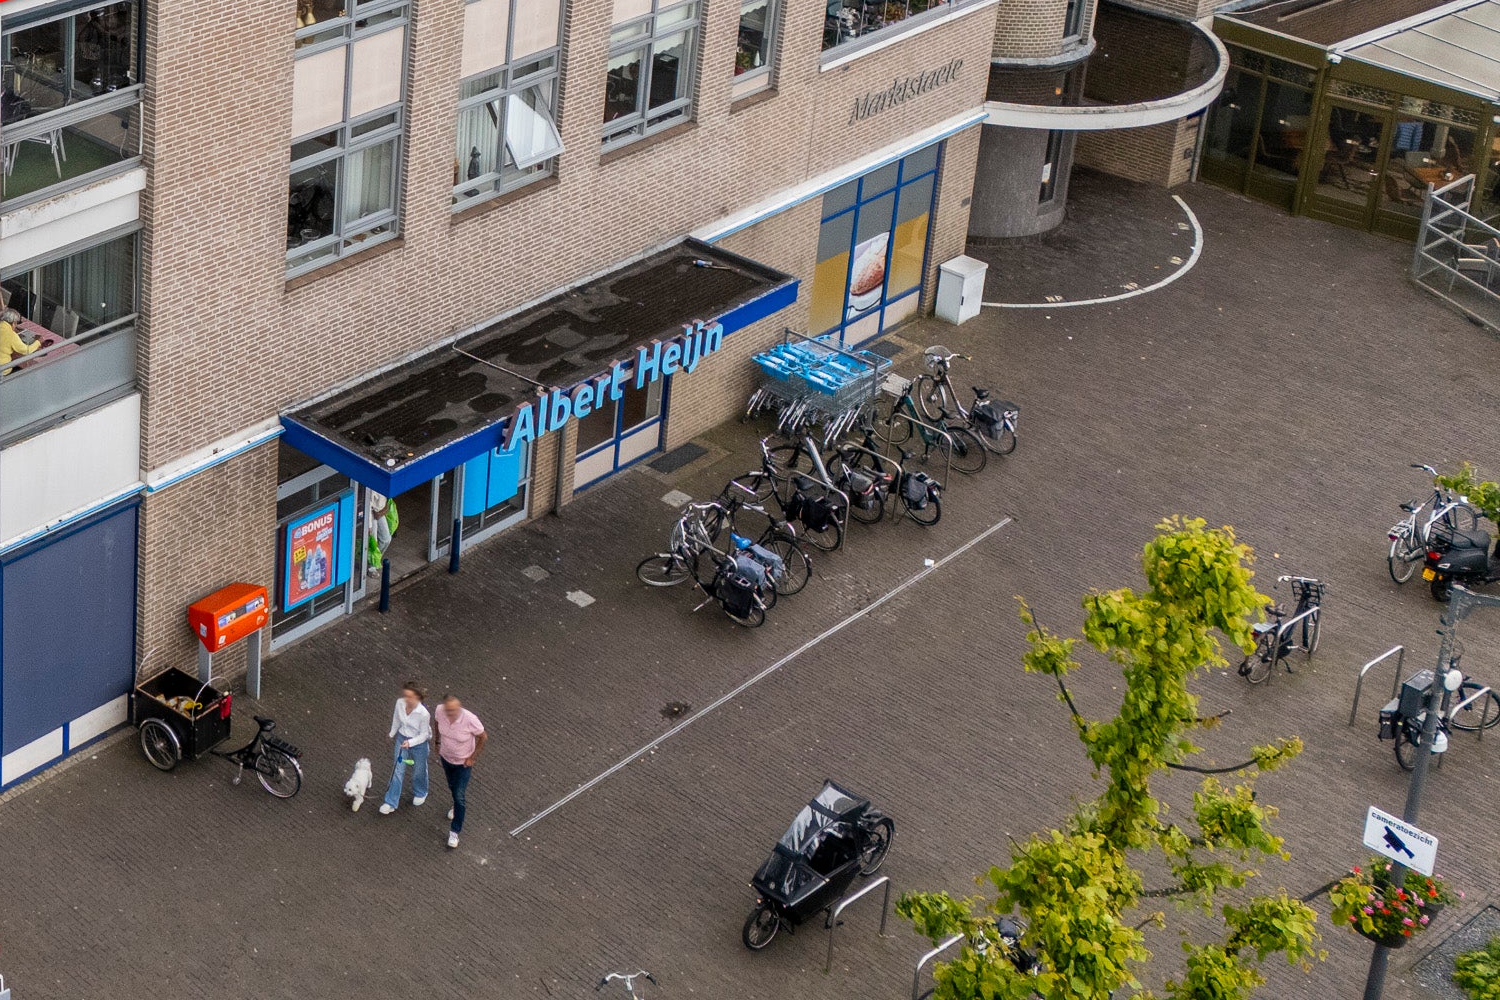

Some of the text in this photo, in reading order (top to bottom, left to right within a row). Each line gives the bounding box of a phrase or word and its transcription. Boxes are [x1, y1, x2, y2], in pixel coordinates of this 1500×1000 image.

[504, 320, 723, 451] Albert Heijn
[301, 513, 333, 538] BONUS
[1371, 811, 1433, 846] cameratoezicht
